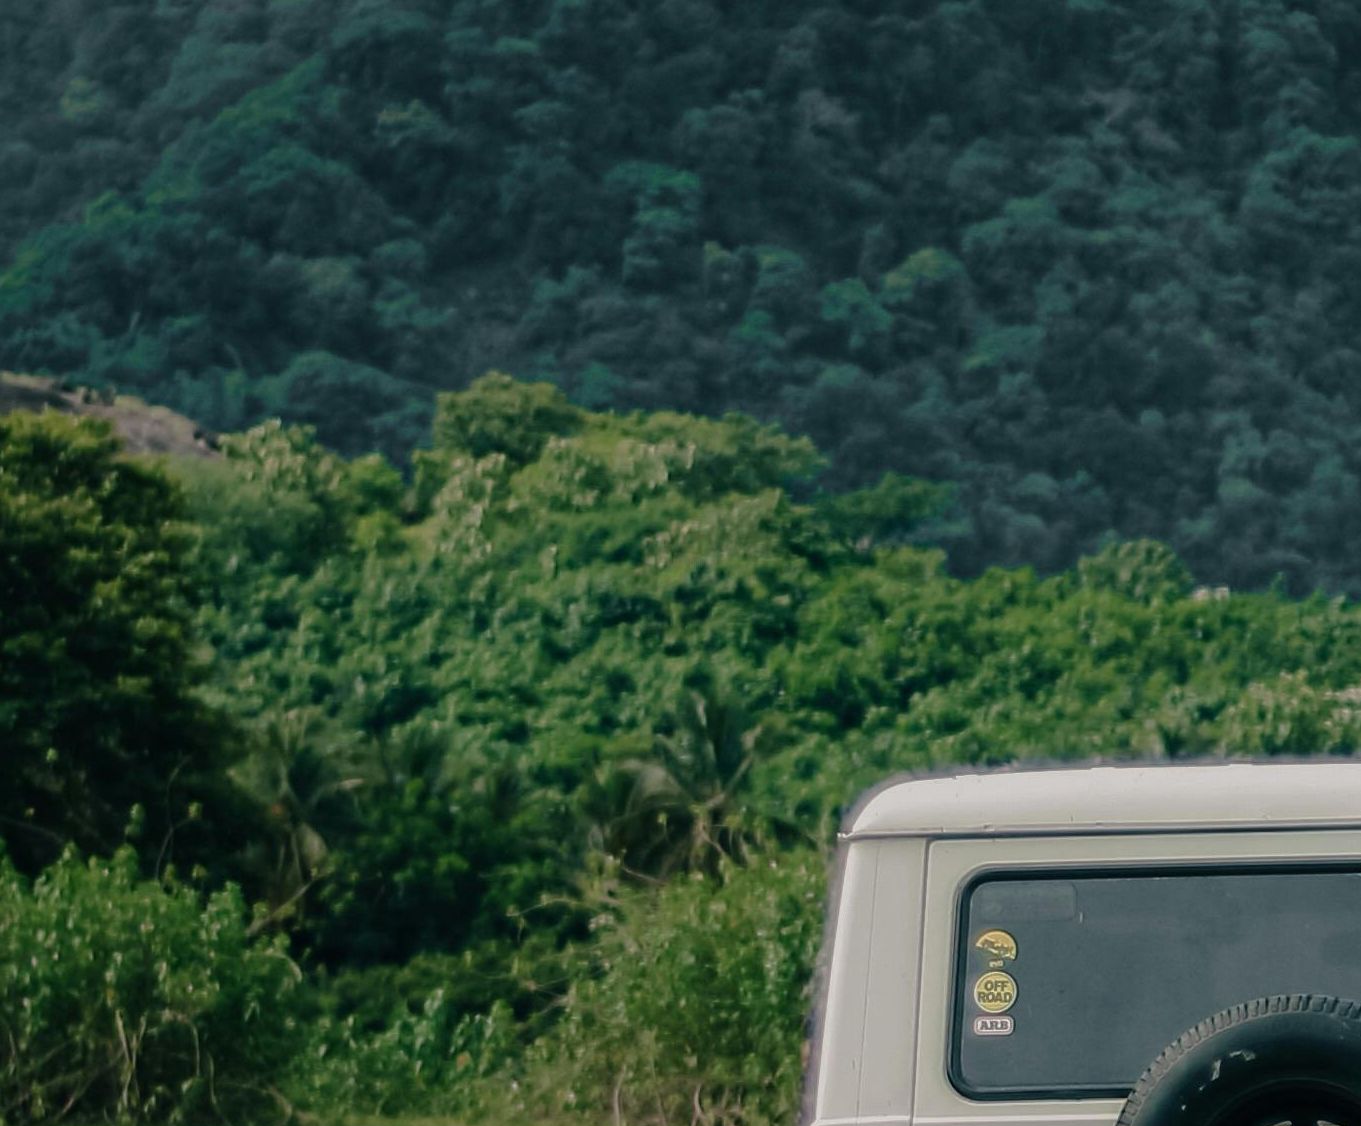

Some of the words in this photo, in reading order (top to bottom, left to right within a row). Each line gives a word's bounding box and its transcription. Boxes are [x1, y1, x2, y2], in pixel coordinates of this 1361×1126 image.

[984, 980, 1009, 991] OFF
[977, 992, 1013, 1003] ROAD
[980, 1020, 1009, 1030] ARB
